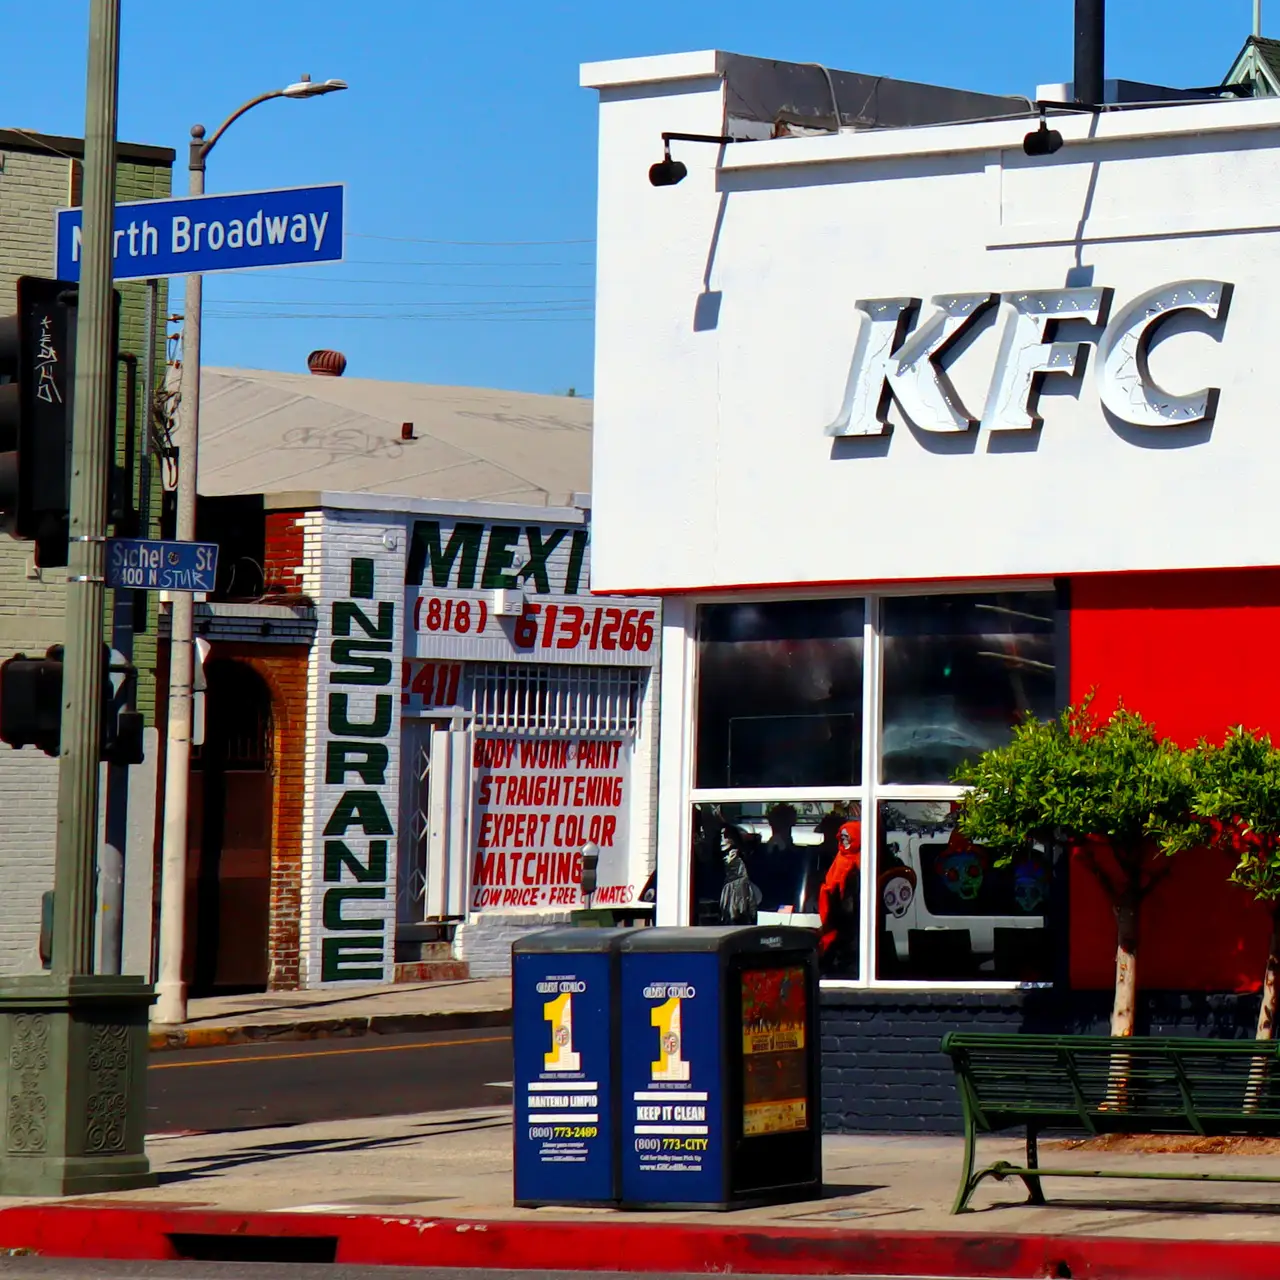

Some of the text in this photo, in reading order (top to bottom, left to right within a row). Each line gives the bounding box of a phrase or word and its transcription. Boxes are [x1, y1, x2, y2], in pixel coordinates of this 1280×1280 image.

[72, 209, 329, 261] Nrth Broadway
[824, 279, 1235, 437] KFC
[112, 542, 213, 571] Sichel St
[405, 521, 591, 595] MEXI
[148, 568, 158, 586] N
[413, 597, 488, 633] (818)
[321, 558, 394, 982] INSURANCE
[473, 738, 517, 768] BODY
[519, 739, 572, 769] WORK
[576, 739, 623, 769] PAINT
[478, 776, 624, 807] STRAIGHTENING
[478, 813, 617, 848] EXPERT COLOR
[472, 851, 583, 886] MATCHING
[473, 884, 635, 907] LOW PRICE FREE EIMATES
[544, 992, 580, 1071] 1
[651, 997, 690, 1081] 1
[570, 1095, 598, 1107] LIMPIO
[636, 1106, 706, 1121] KEEP IT CLEAN
[529, 1126, 598, 1140] (800) 773-2489
[634, 1138, 709, 1152] (800) 773-CITY
